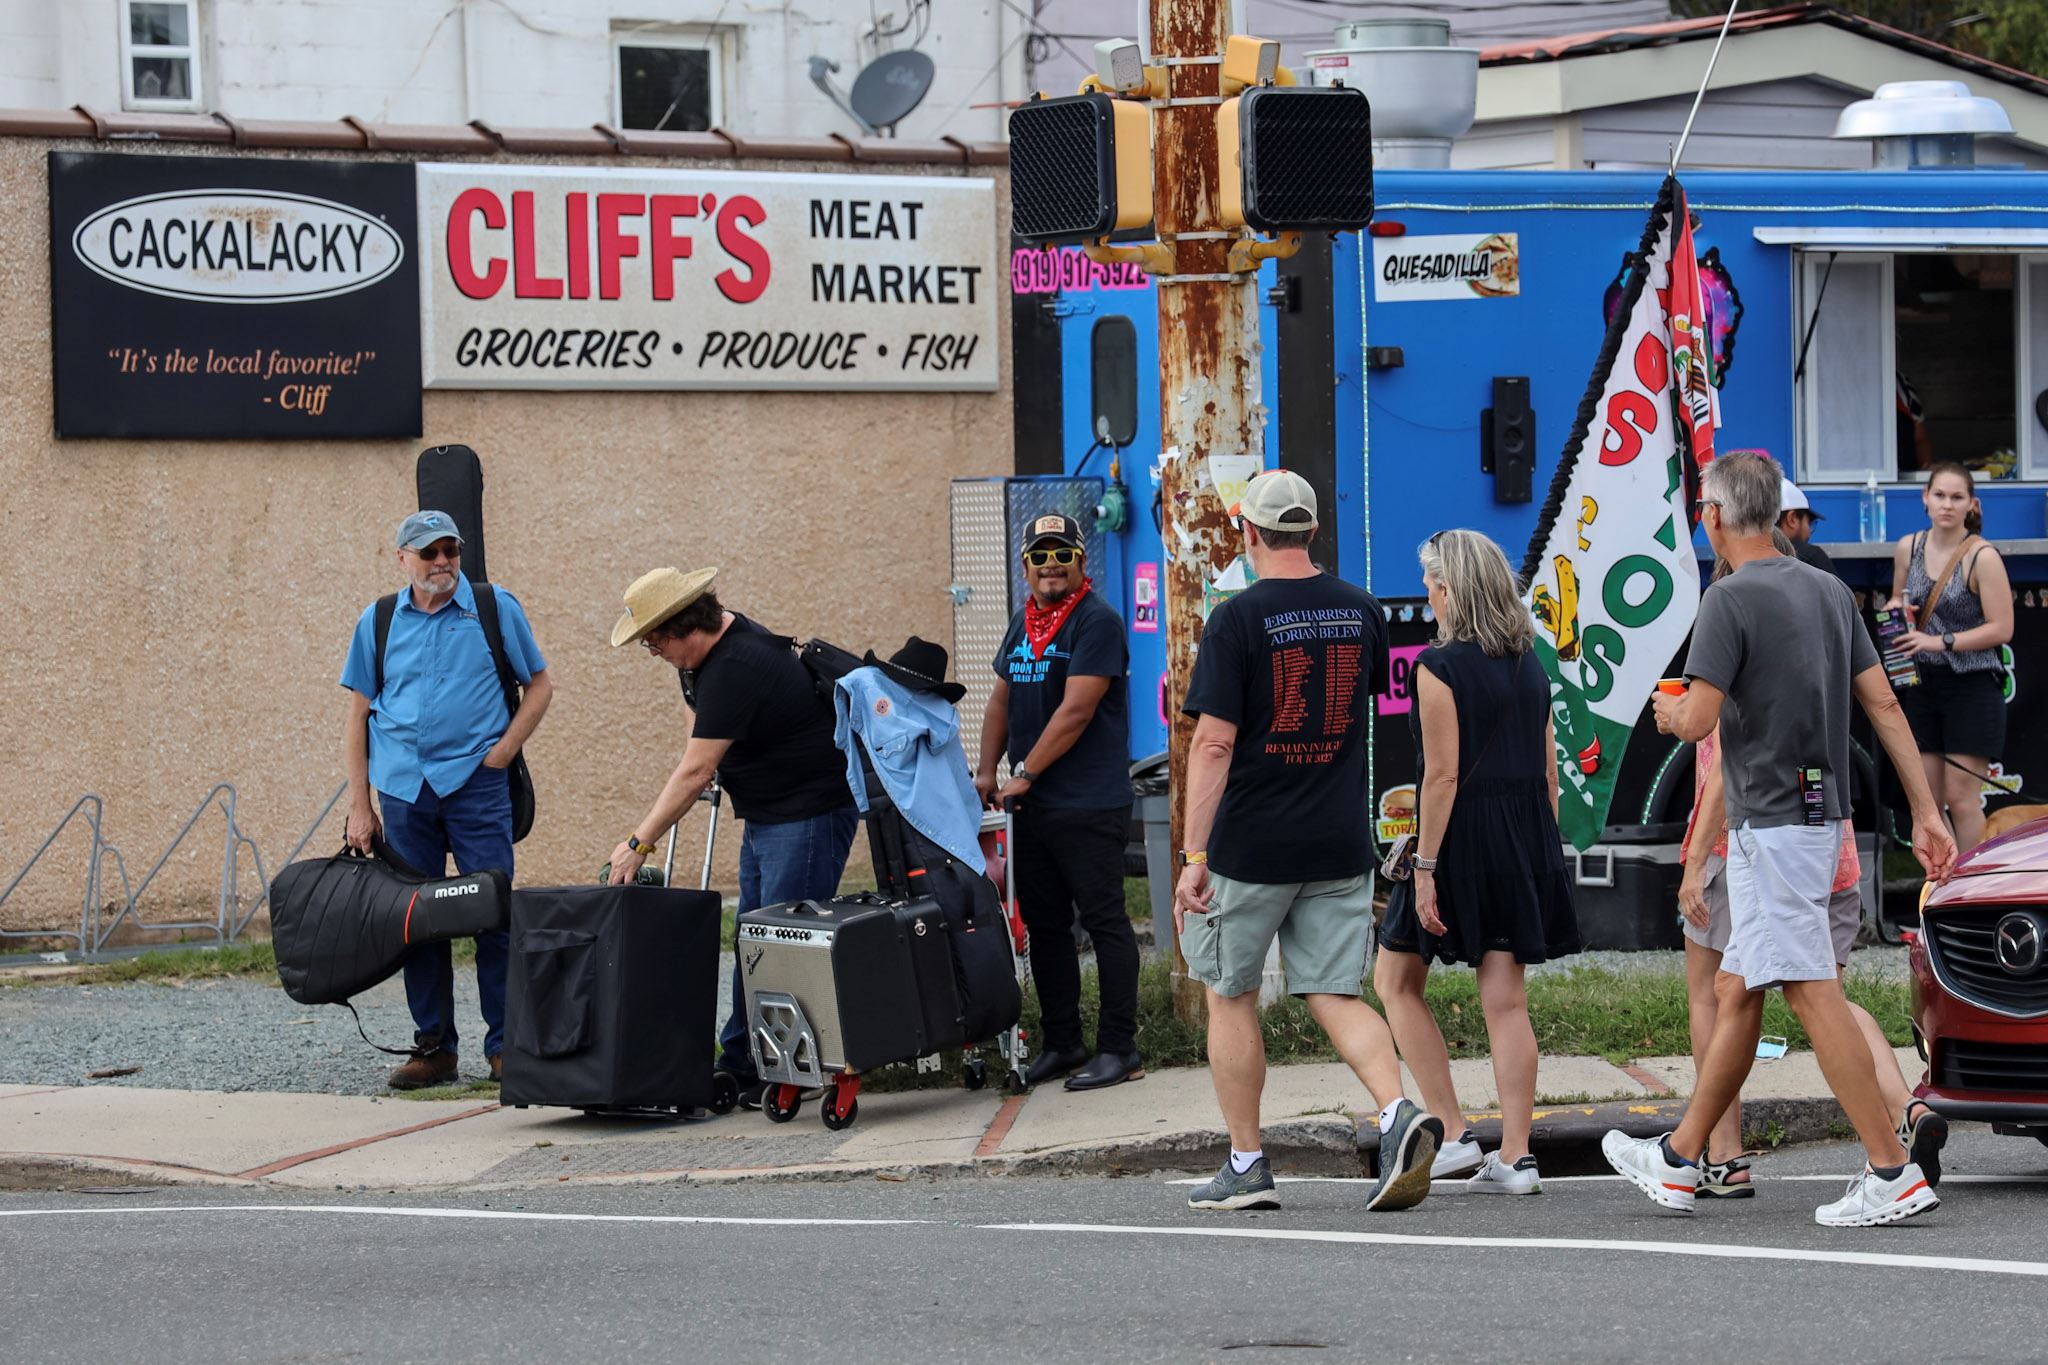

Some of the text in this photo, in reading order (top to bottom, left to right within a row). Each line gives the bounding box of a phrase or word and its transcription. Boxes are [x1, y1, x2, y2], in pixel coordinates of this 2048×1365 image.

[810, 199, 924, 241] MEAT
[109, 217, 369, 273] CACKALACKY
[446, 187, 772, 304] CLIFF'S
[1013, 251, 1057, 289] (919)
[1384, 252, 1490, 283] QUESADILLA
[812, 263, 982, 305] MARKET
[164, 349, 199, 374] the
[206, 349, 261, 374] local
[455, 328, 980, 371] GROCERIES PRODUCE FISH
[279, 384, 332, 415] Cliff
[1264, 608, 1363, 630] JERRY HARRISON
[1270, 626, 1362, 645] ADRIAN BELEW
[1009, 662, 1033, 674] BOOM
[435, 884, 479, 899] mono
